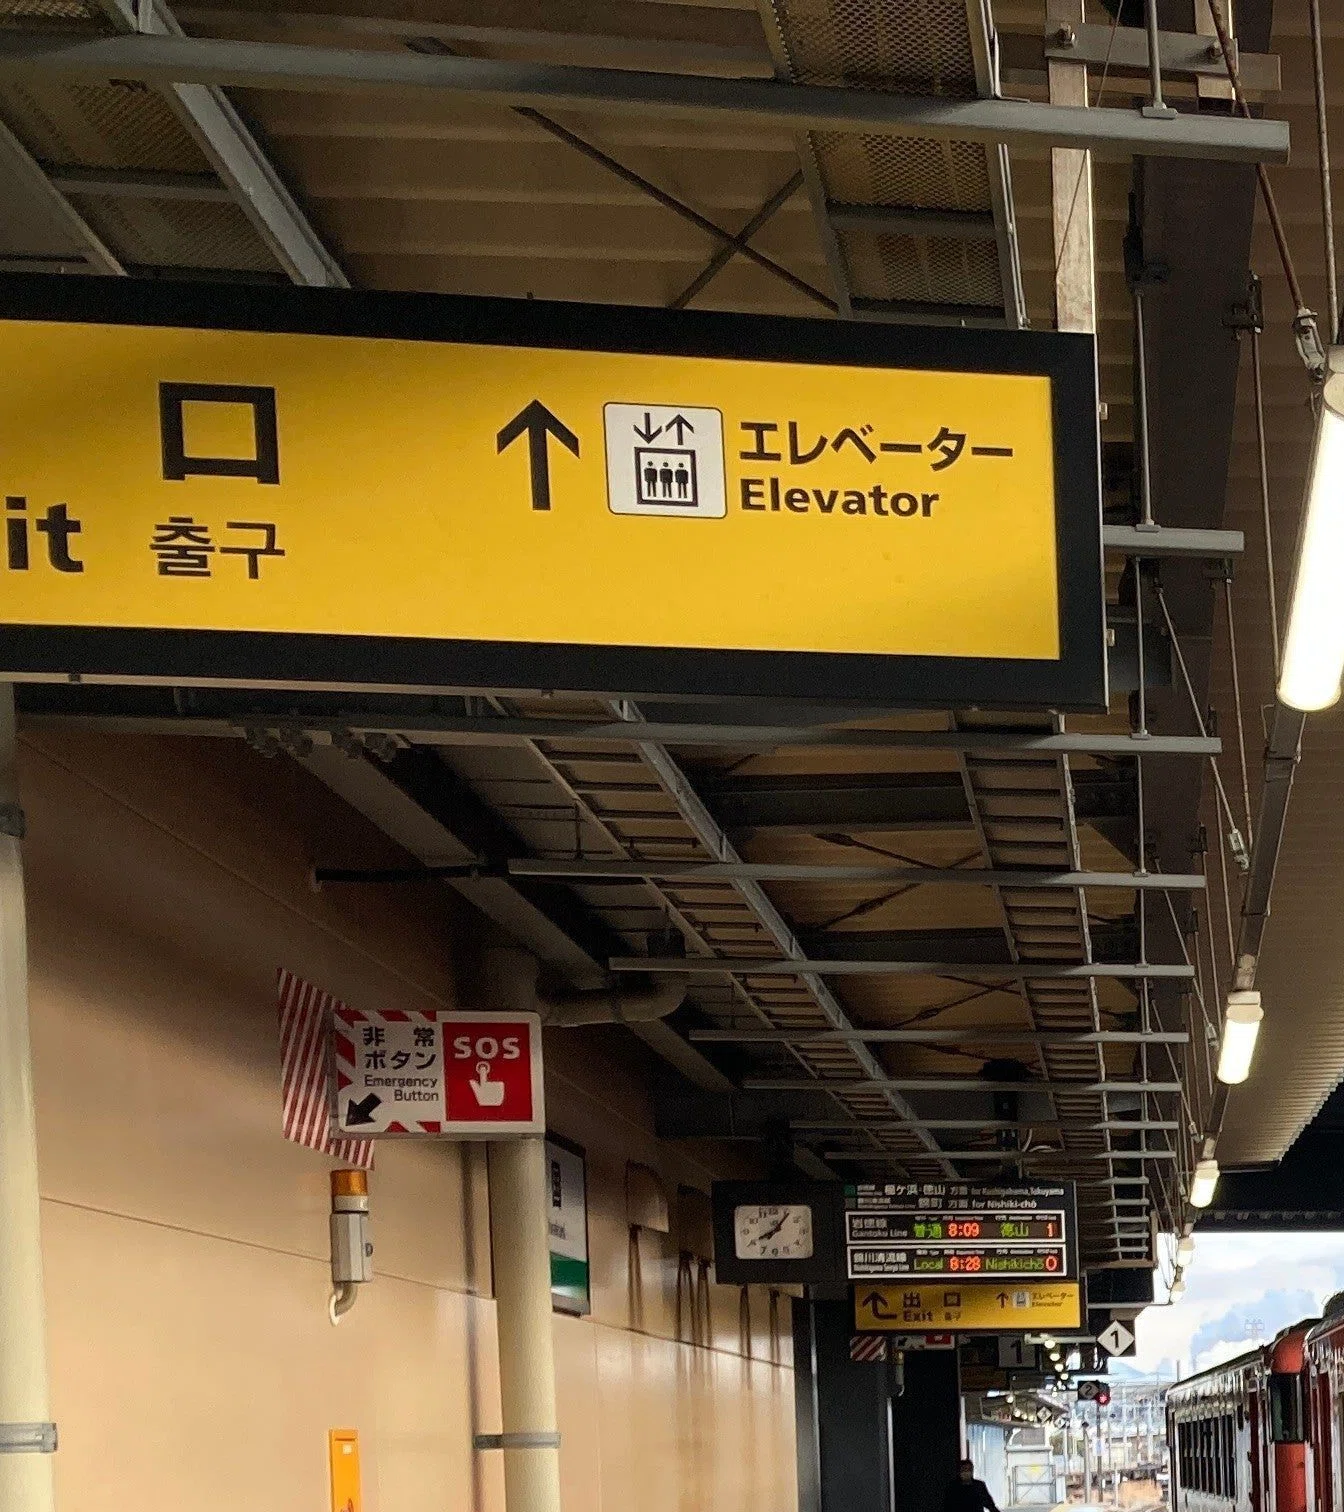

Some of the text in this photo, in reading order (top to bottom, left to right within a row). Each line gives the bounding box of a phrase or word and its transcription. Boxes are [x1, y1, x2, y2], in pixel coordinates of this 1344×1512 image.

[159, 380, 280, 485] 口
[739, 421, 1013, 472] エレベーター
[740, 477, 940, 518] Elevator
[149, 516, 285, 579] 출구
[453, 1036, 521, 1060] SOS
[364, 1050, 437, 1070] ボタン
[364, 1074, 438, 1088] Emergency
[394, 1089, 439, 1101] Button
[948, 1222, 980, 1238] 8:09
[1046, 1222, 1054, 1238] 1
[914, 1258, 944, 1271] Local
[949, 1256, 981, 1271] 8:28
[903, 1309, 933, 1322] Exit
[1110, 1330, 1120, 1349] 1
[1011, 1340, 1022, 1364] 1
